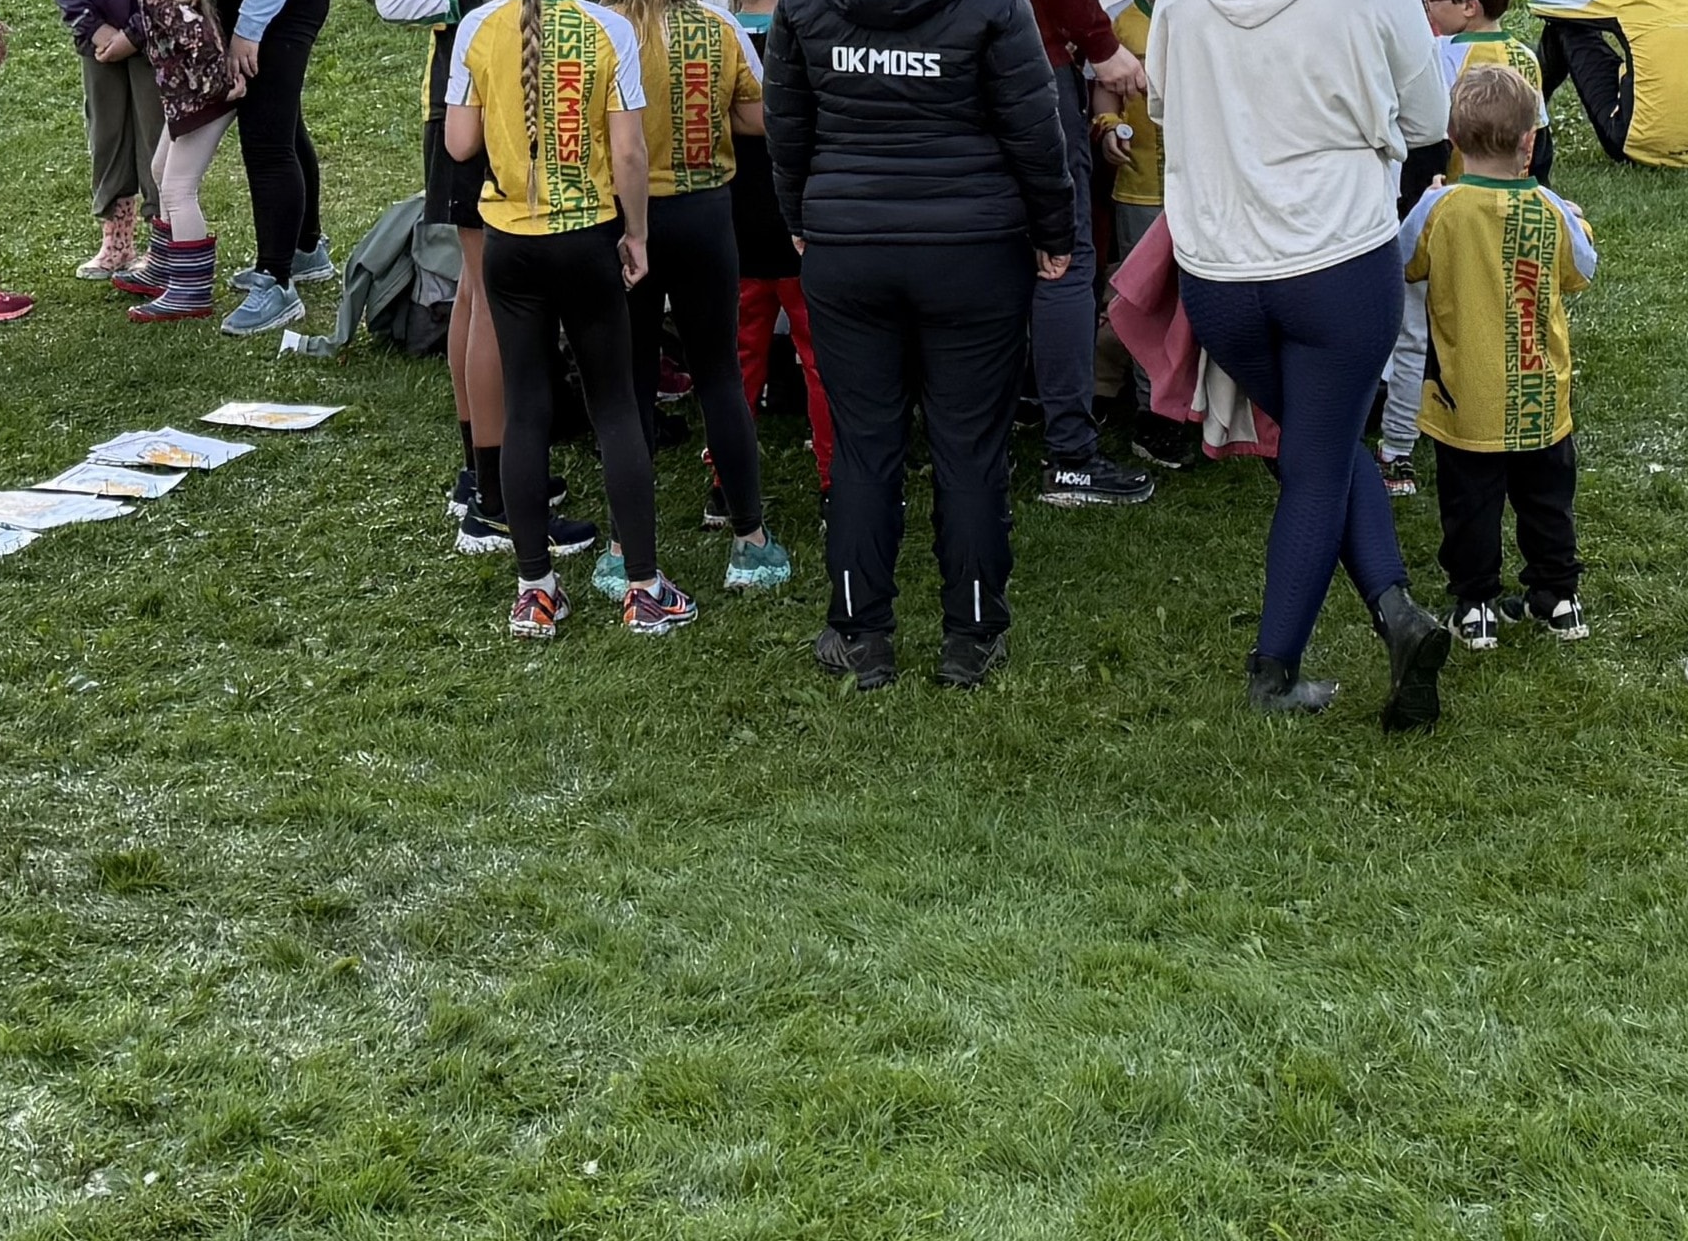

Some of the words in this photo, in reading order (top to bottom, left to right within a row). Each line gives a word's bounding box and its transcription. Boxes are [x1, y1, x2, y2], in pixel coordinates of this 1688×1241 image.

[557, 62, 581, 93] OK
[832, 46, 866, 73] OK
[868, 48, 941, 77] MOSS
[542, 70, 556, 106] MOSS
[685, 63, 708, 100] OK
[557, 97, 581, 163] MOSS
[560, 164, 582, 194] OK
[1515, 260, 1539, 294] OK
[1505, 311, 1519, 331] OK
[1515, 297, 1543, 371] MOSS
[1505, 332, 1519, 373] MOSS
[1506, 374, 1519, 393] OK
[1521, 373, 1543, 410] OK
[1505, 394, 1519, 435] MOSS
[1055, 470, 1091, 486] HOKA
